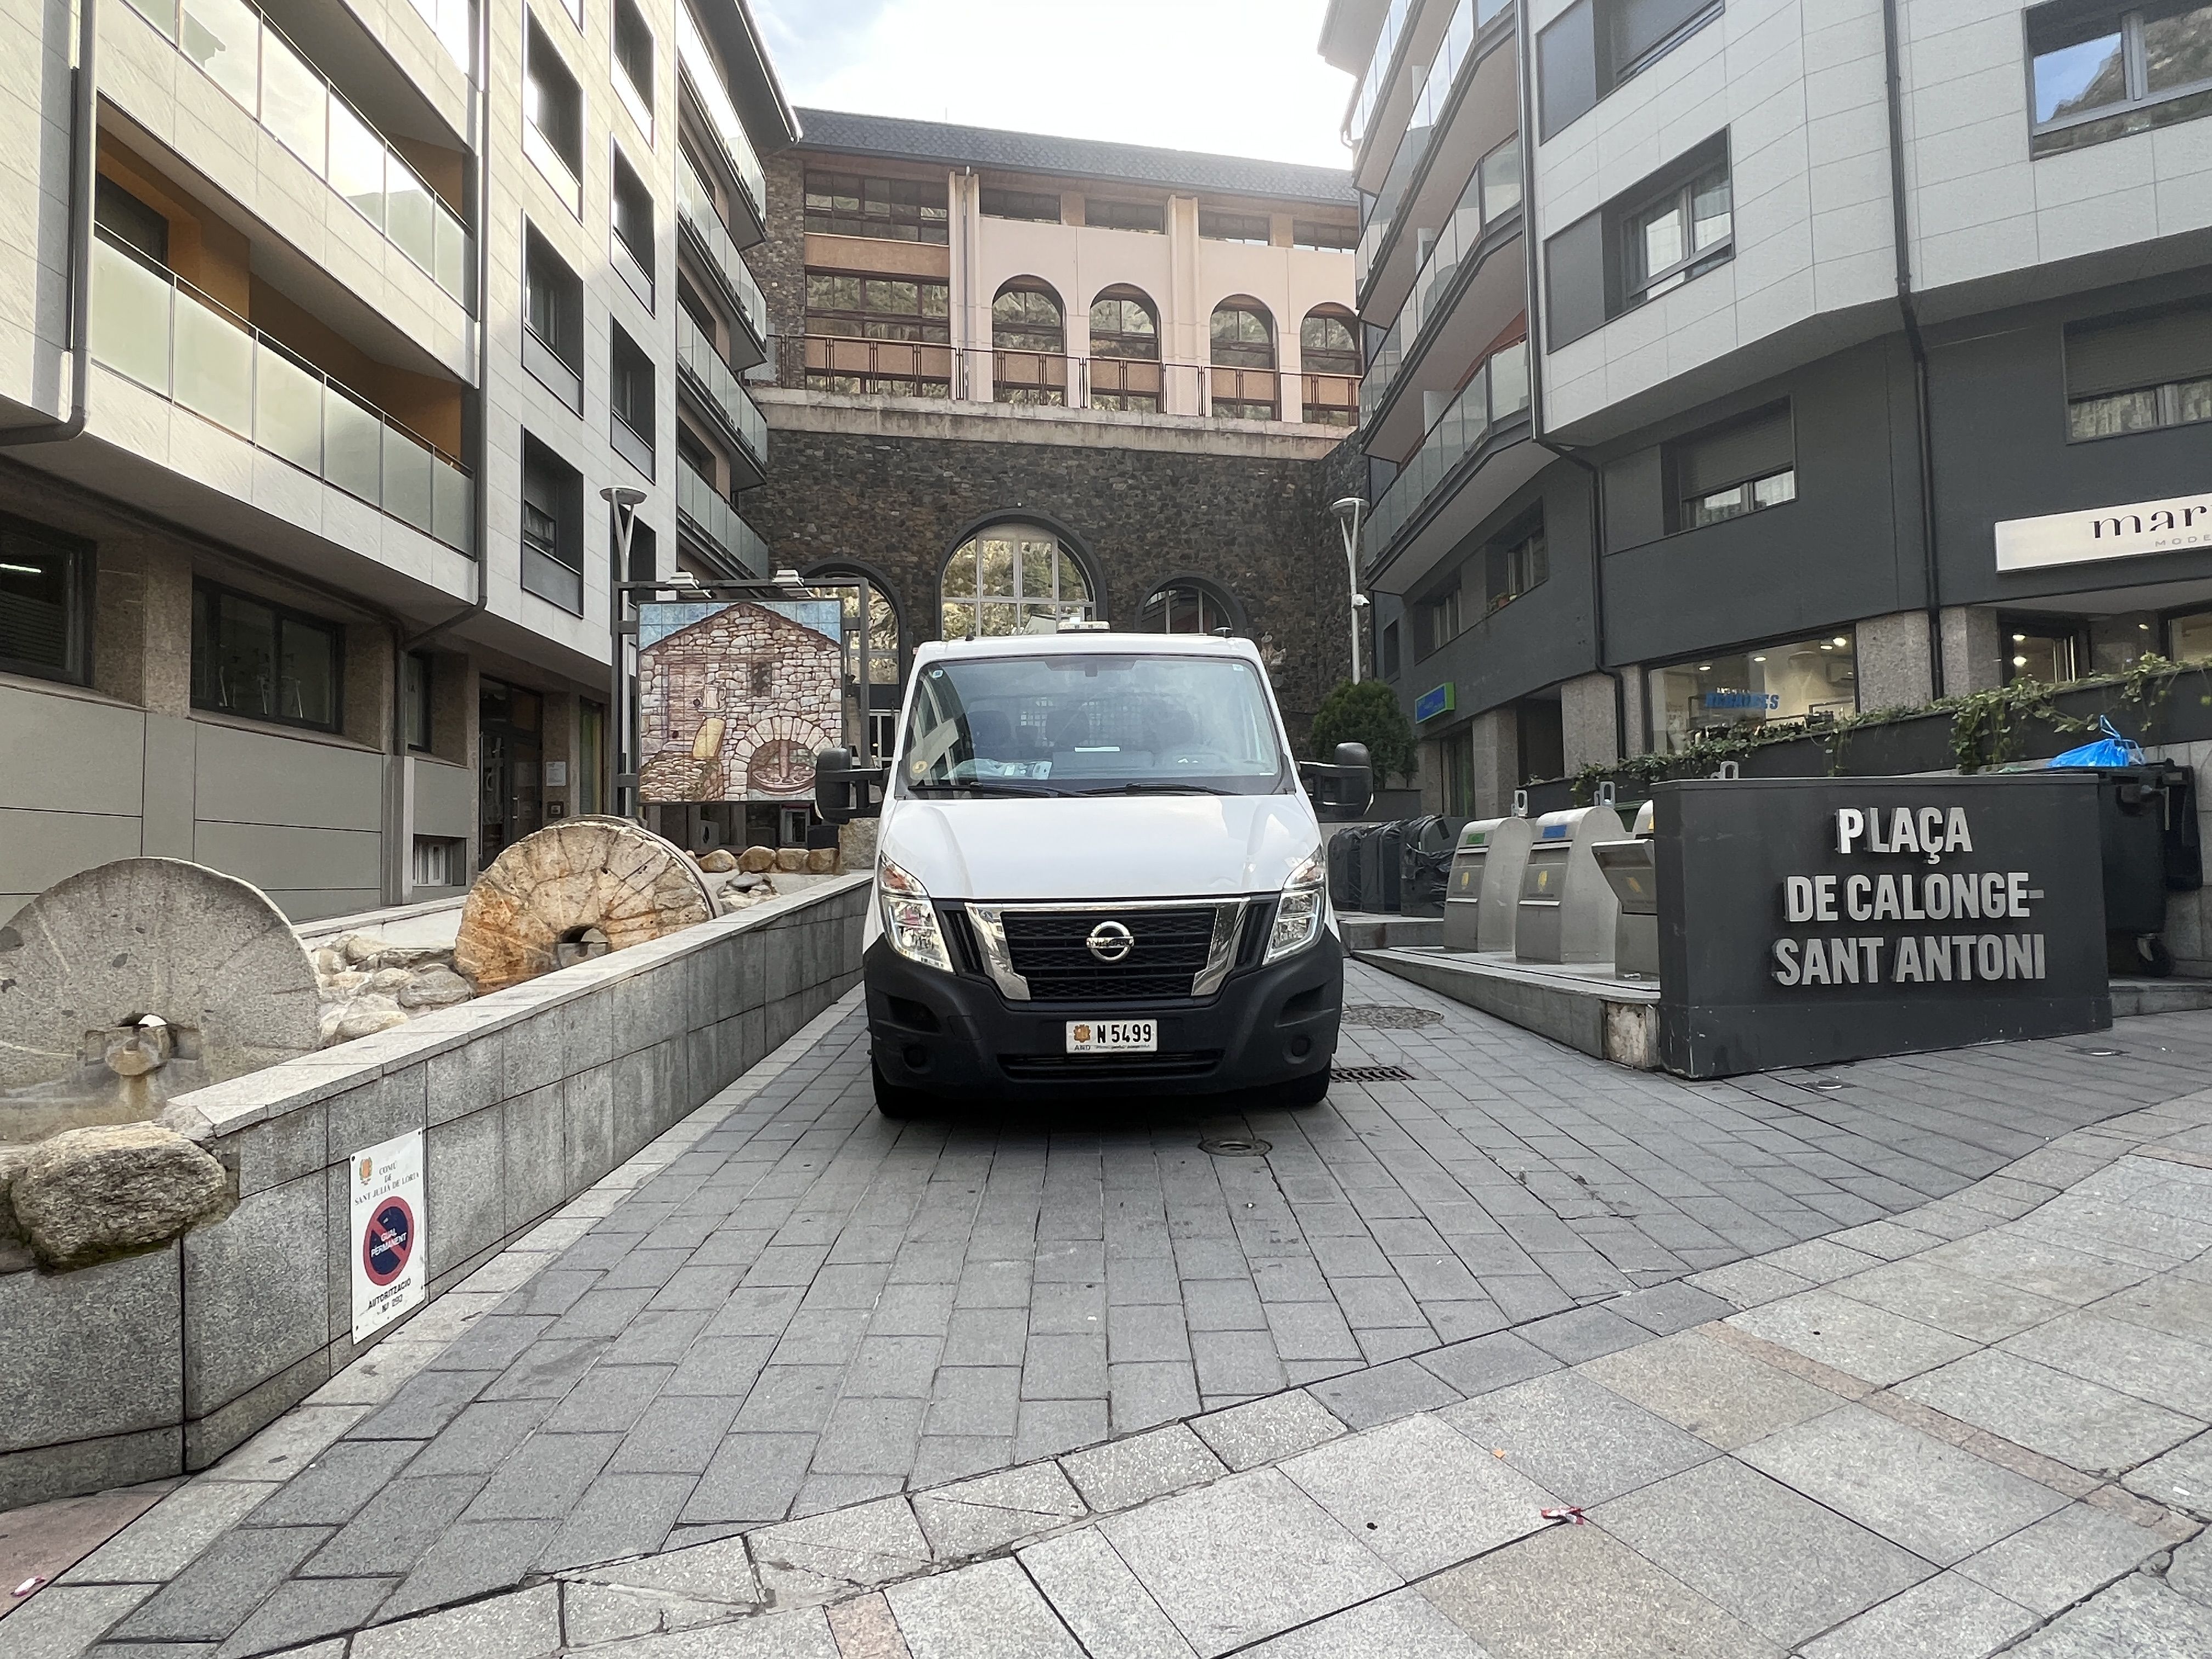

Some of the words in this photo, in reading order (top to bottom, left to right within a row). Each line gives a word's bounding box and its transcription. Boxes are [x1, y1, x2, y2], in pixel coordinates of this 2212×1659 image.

[2089, 505, 2212, 539] mar
[1836, 807, 1973, 865] PLAÇA
[1784, 875, 1839, 922] DE
[1844, 872, 2044, 921] CALONGE-
[1773, 936, 1884, 986] SANT
[1893, 933, 2046, 983] ANTONI
[1097, 1024, 1106, 1043] N
[1111, 1024, 1152, 1043] 5499
[354, 1192, 371, 1206] SANT
[392, 1179, 400, 1189] DE
[371, 1232, 407, 1257] PERMANENT
